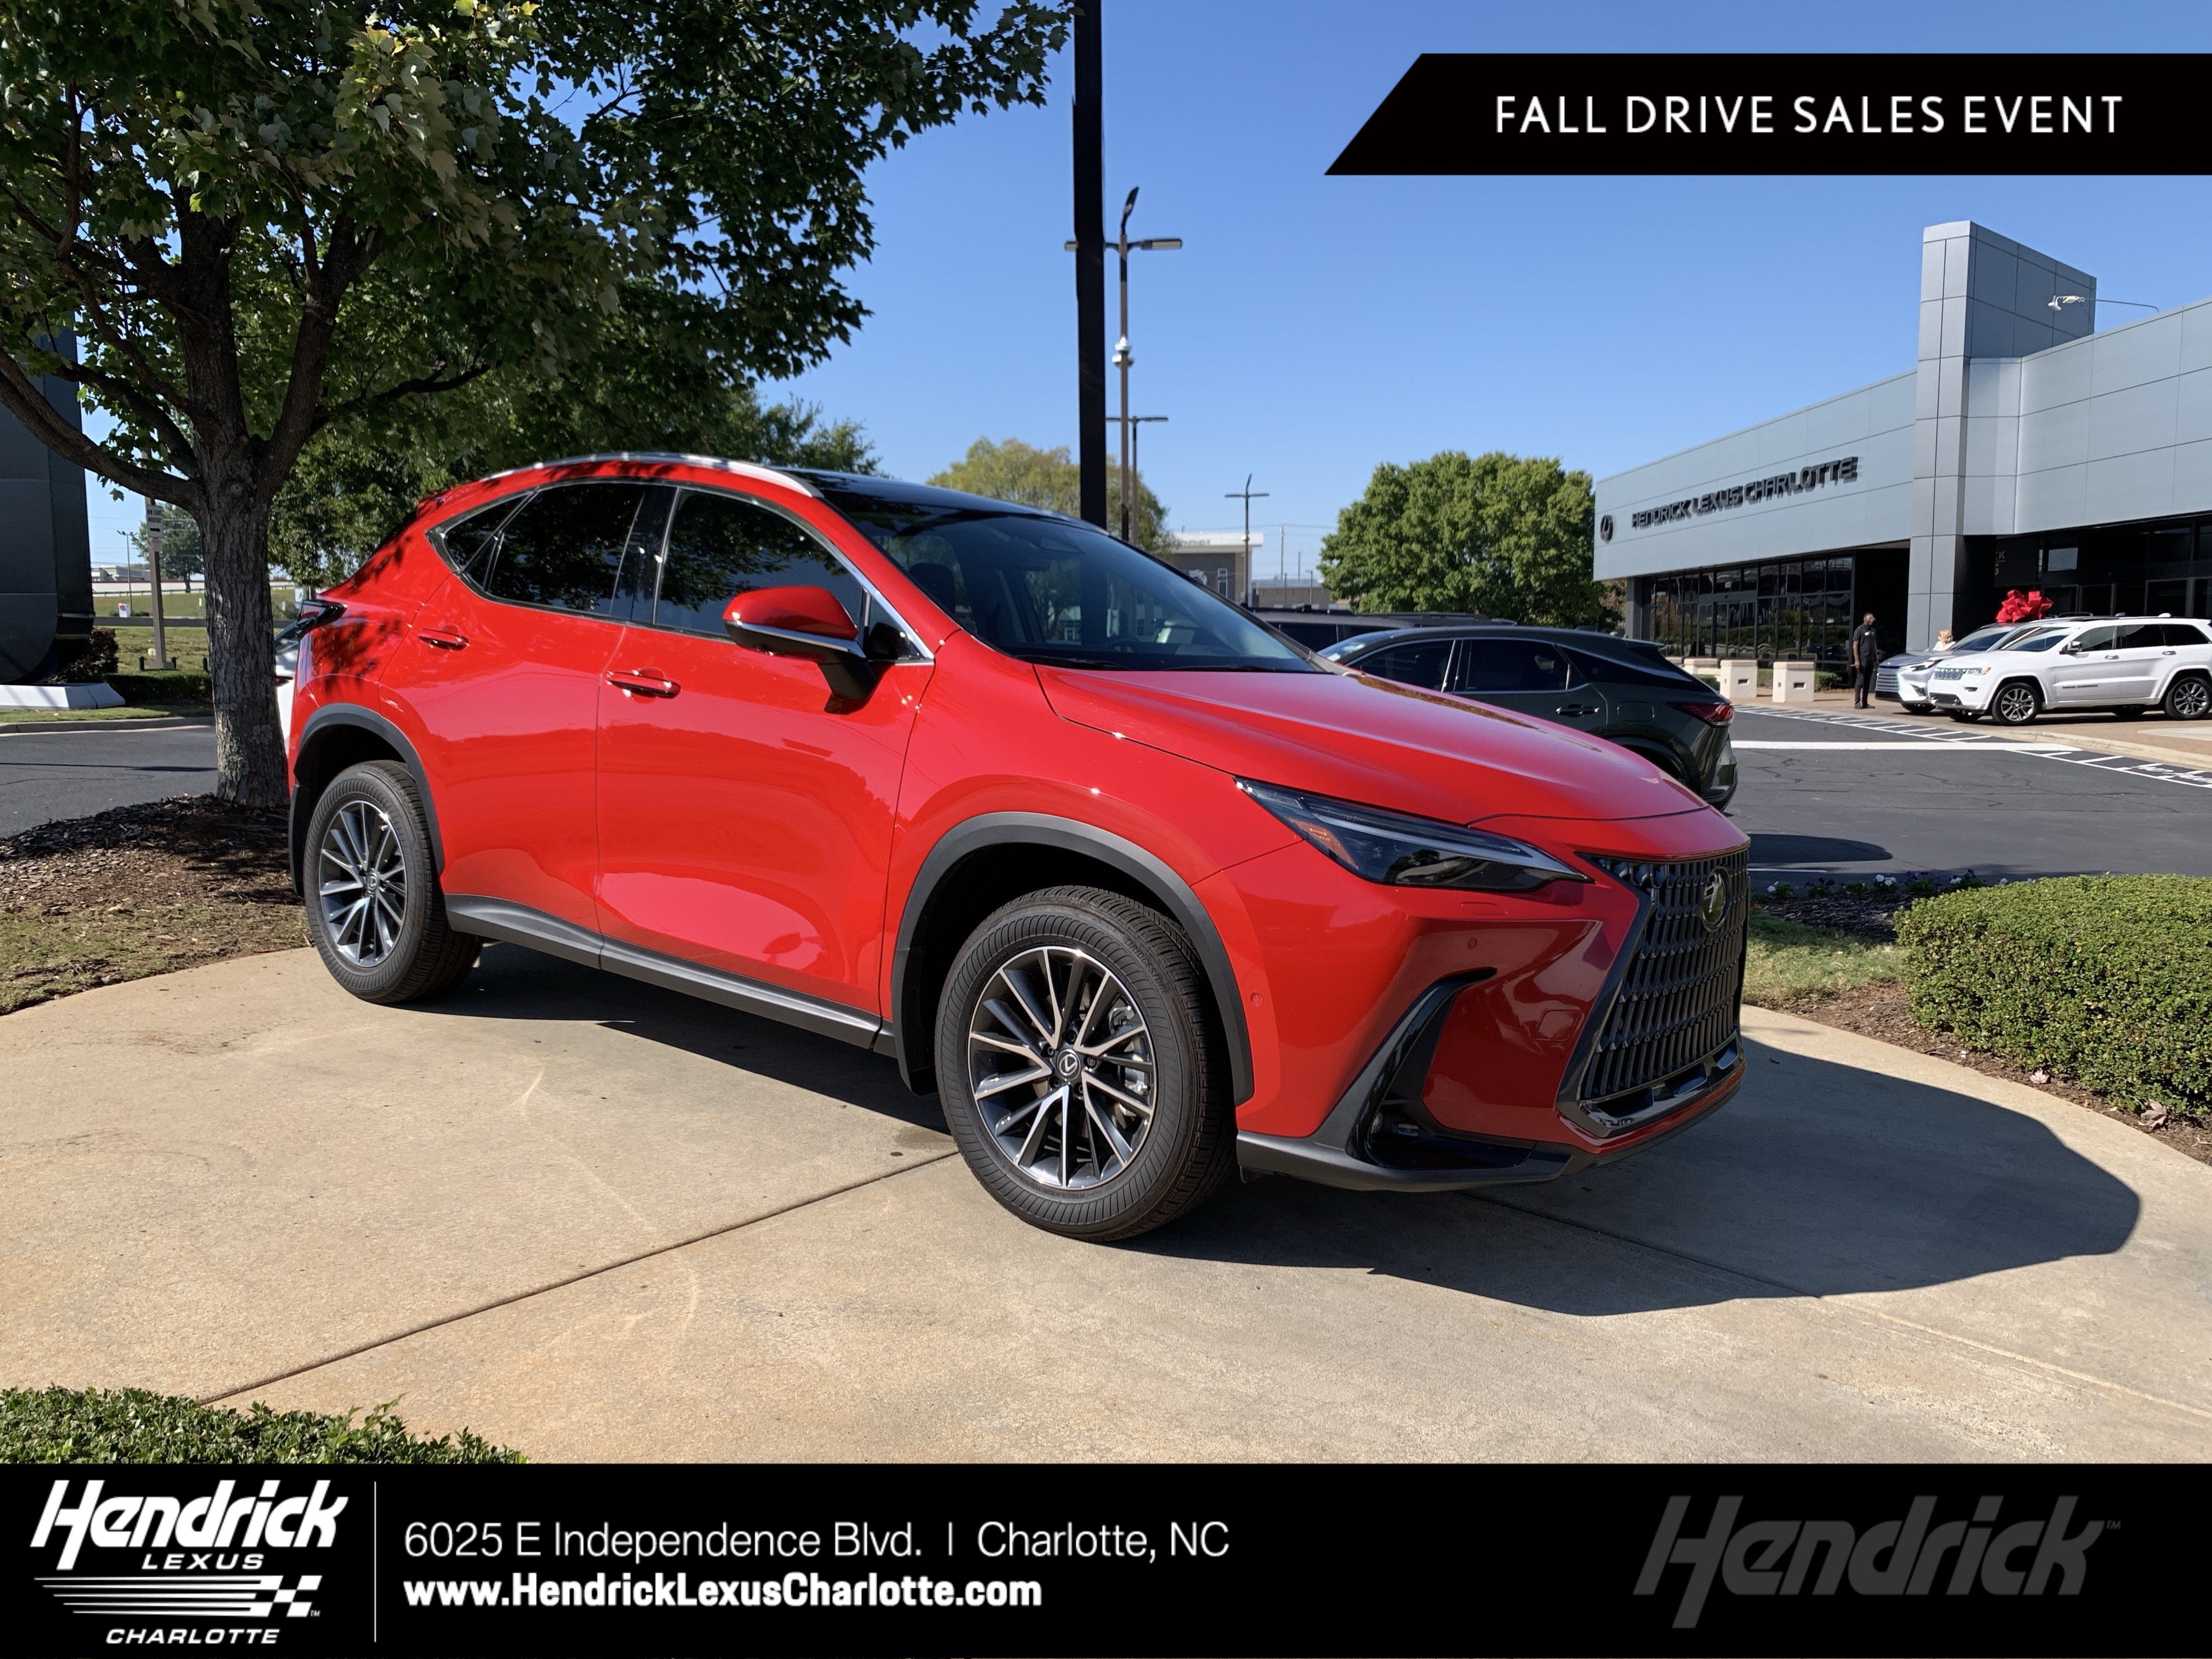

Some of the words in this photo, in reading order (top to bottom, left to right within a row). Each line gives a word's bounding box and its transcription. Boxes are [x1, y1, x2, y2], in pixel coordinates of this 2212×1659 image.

[1632, 500, 1691, 528] HENDRICK
[1691, 486, 1743, 514] LEXUS
[1744, 457, 1858, 500] CHARLOTTE
